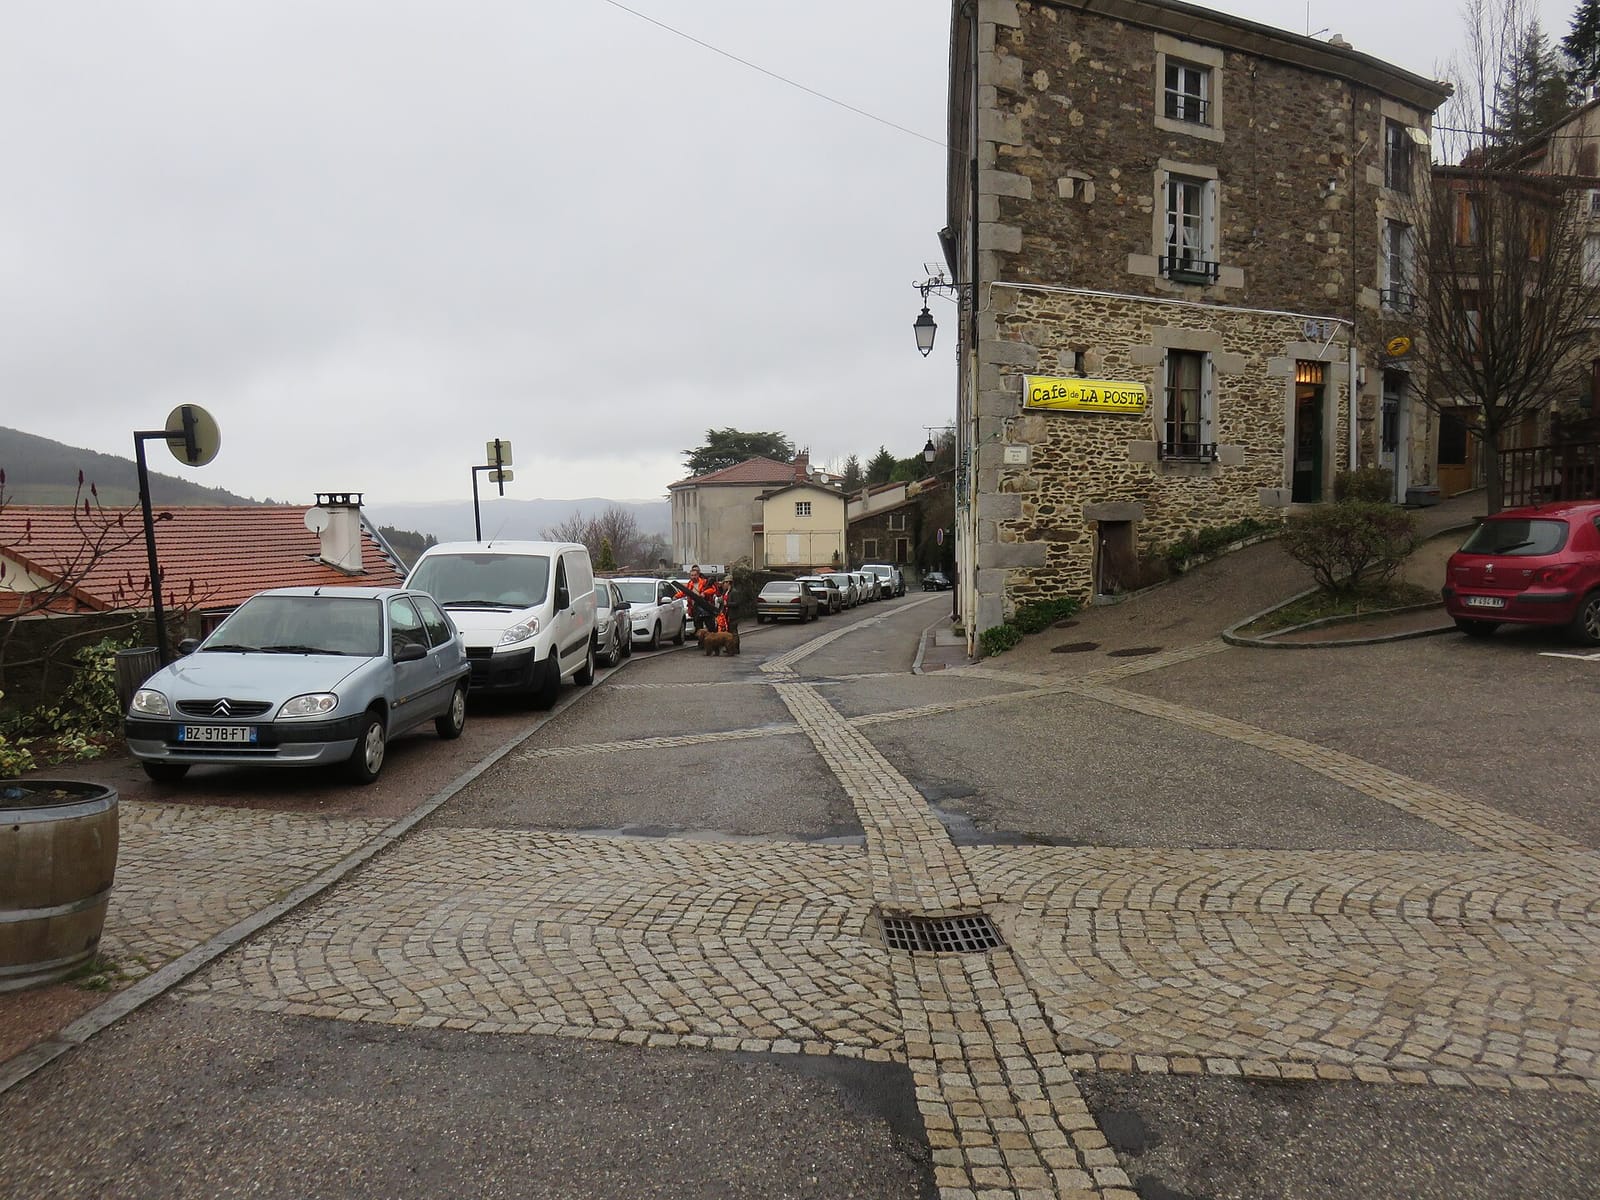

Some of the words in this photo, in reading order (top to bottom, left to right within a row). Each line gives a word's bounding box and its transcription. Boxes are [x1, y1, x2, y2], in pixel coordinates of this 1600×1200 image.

[1032, 384, 1067, 402] Café
[1070, 391, 1079, 399] de
[1080, 389, 1098, 403] LA
[1103, 390, 1144, 405] POSTE
[186, 727, 247, 741] BZ-978-FT
